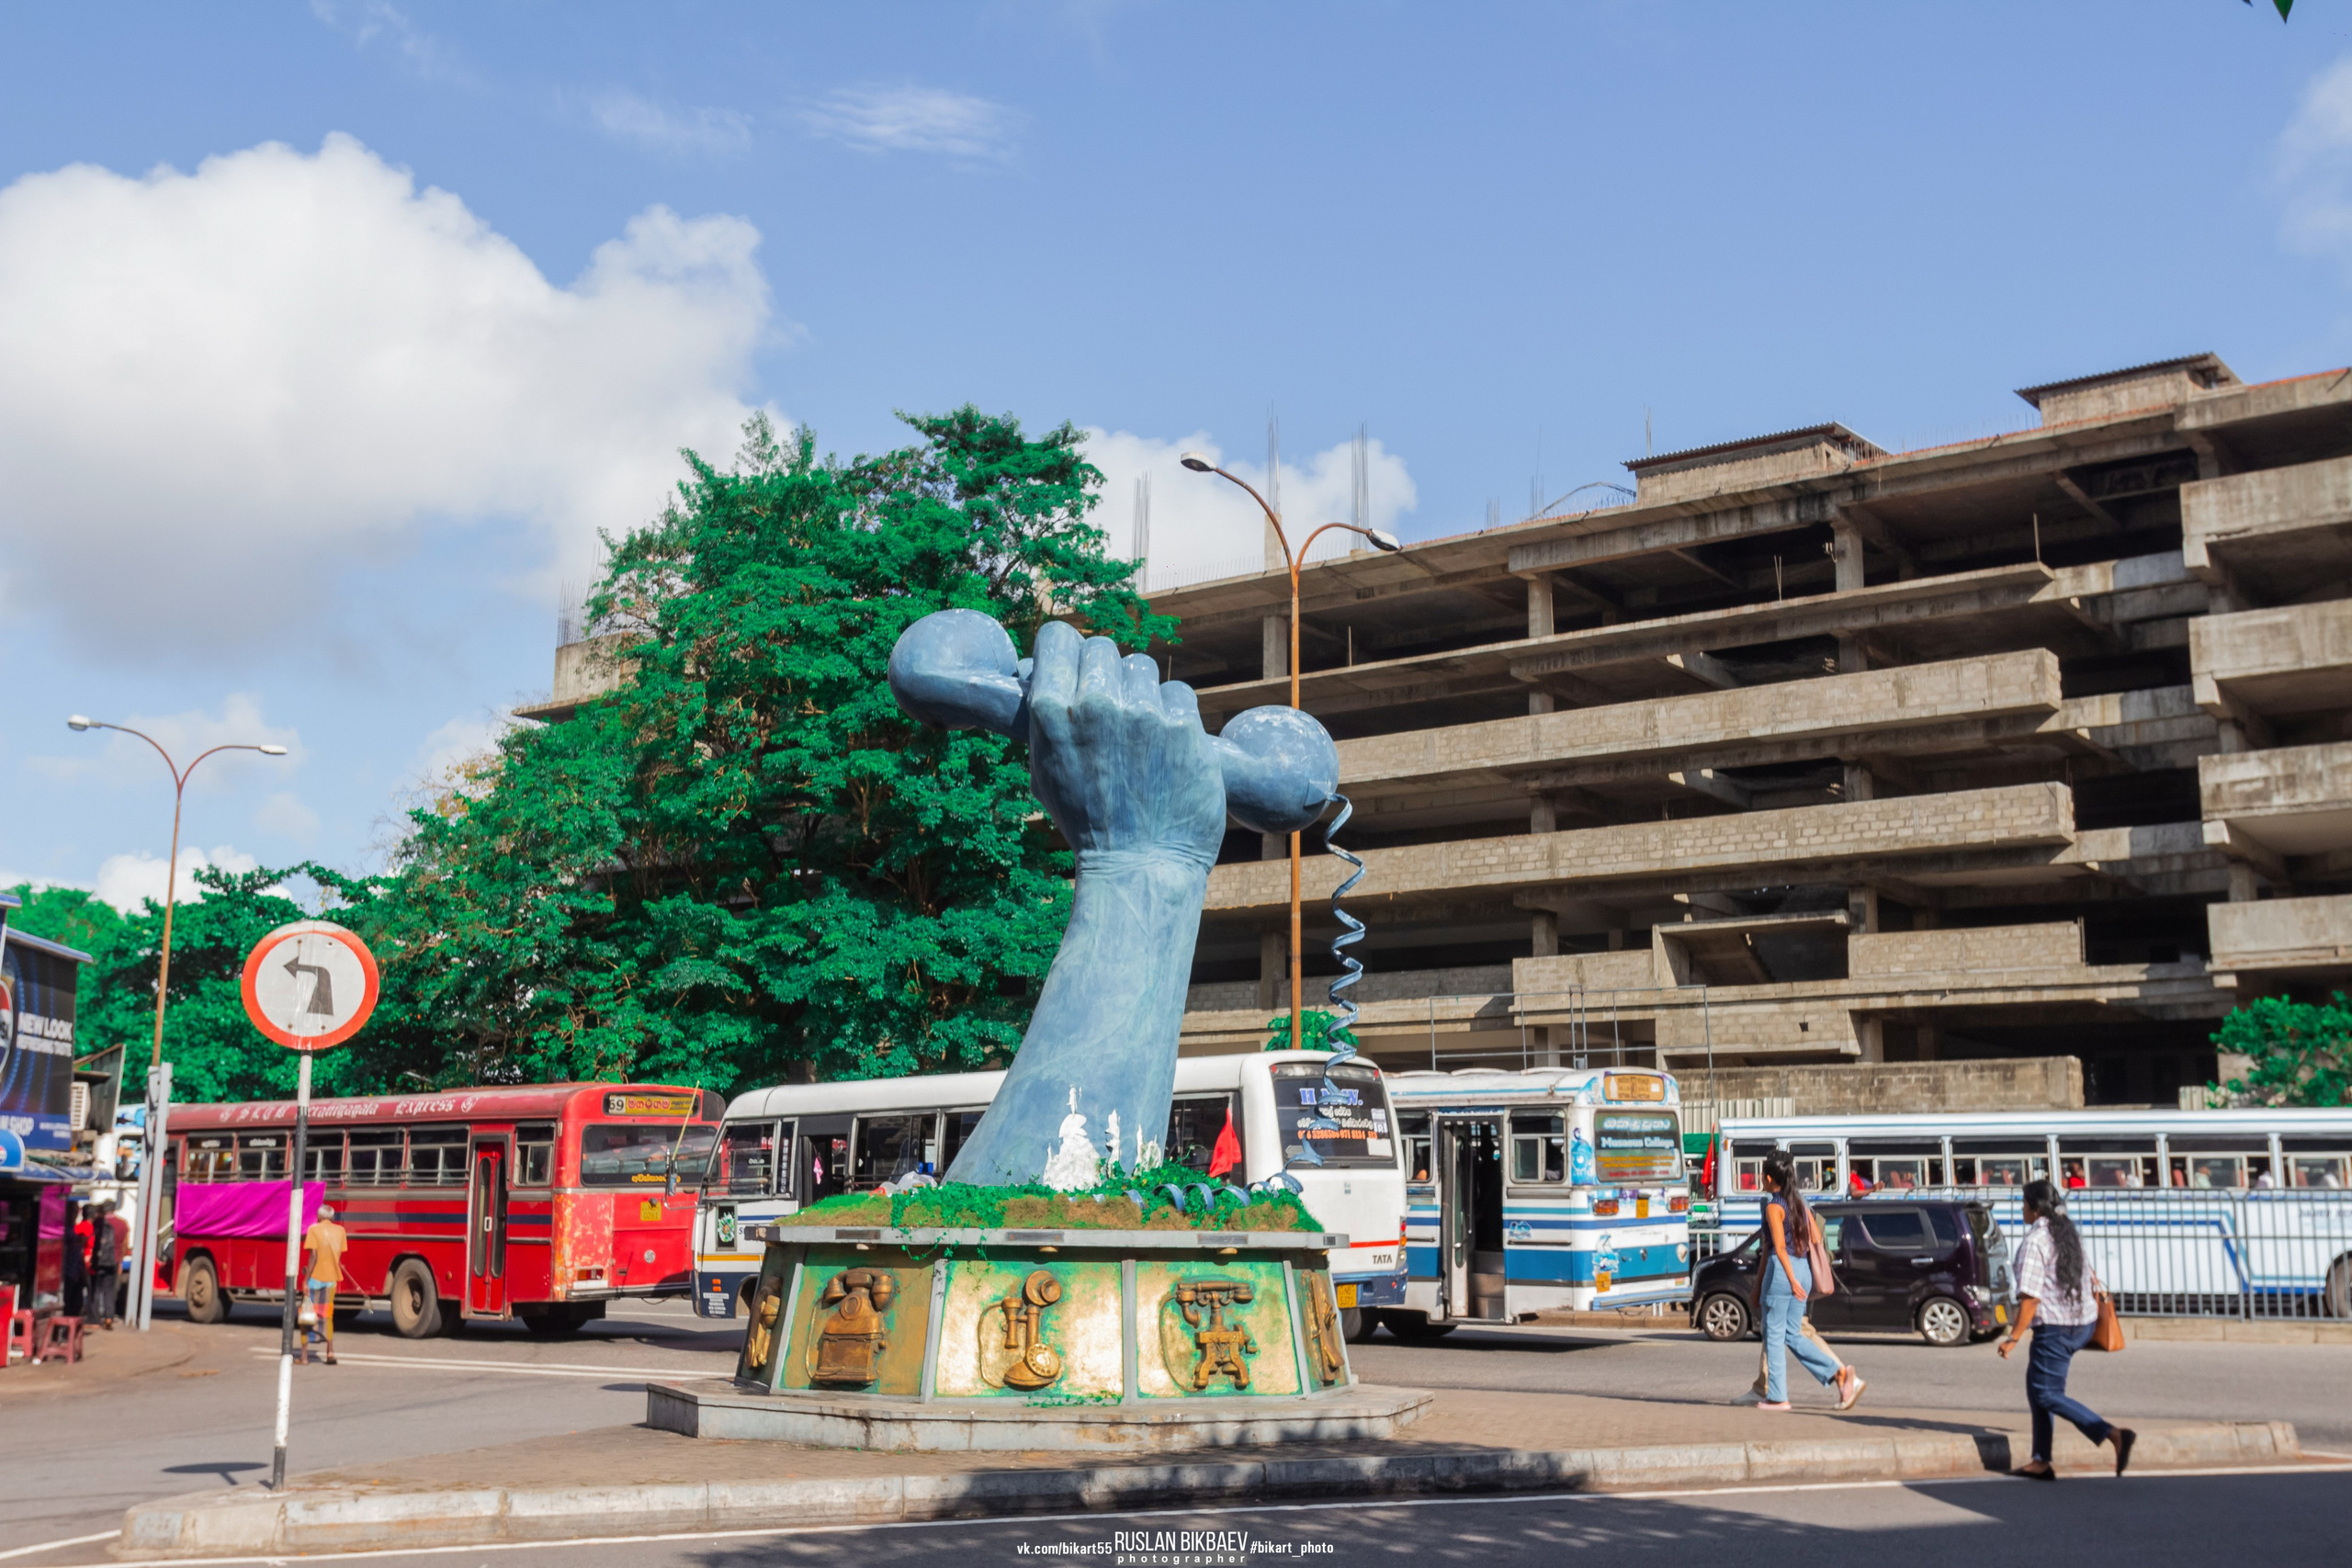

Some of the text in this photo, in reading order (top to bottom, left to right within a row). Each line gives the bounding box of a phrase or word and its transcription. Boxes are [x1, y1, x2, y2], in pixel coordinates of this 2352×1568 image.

[17, 1011, 73, 1042] NEW LOOK
[1644, 1135, 1675, 1149] College
[1373, 1254, 1393, 1264] TATA
